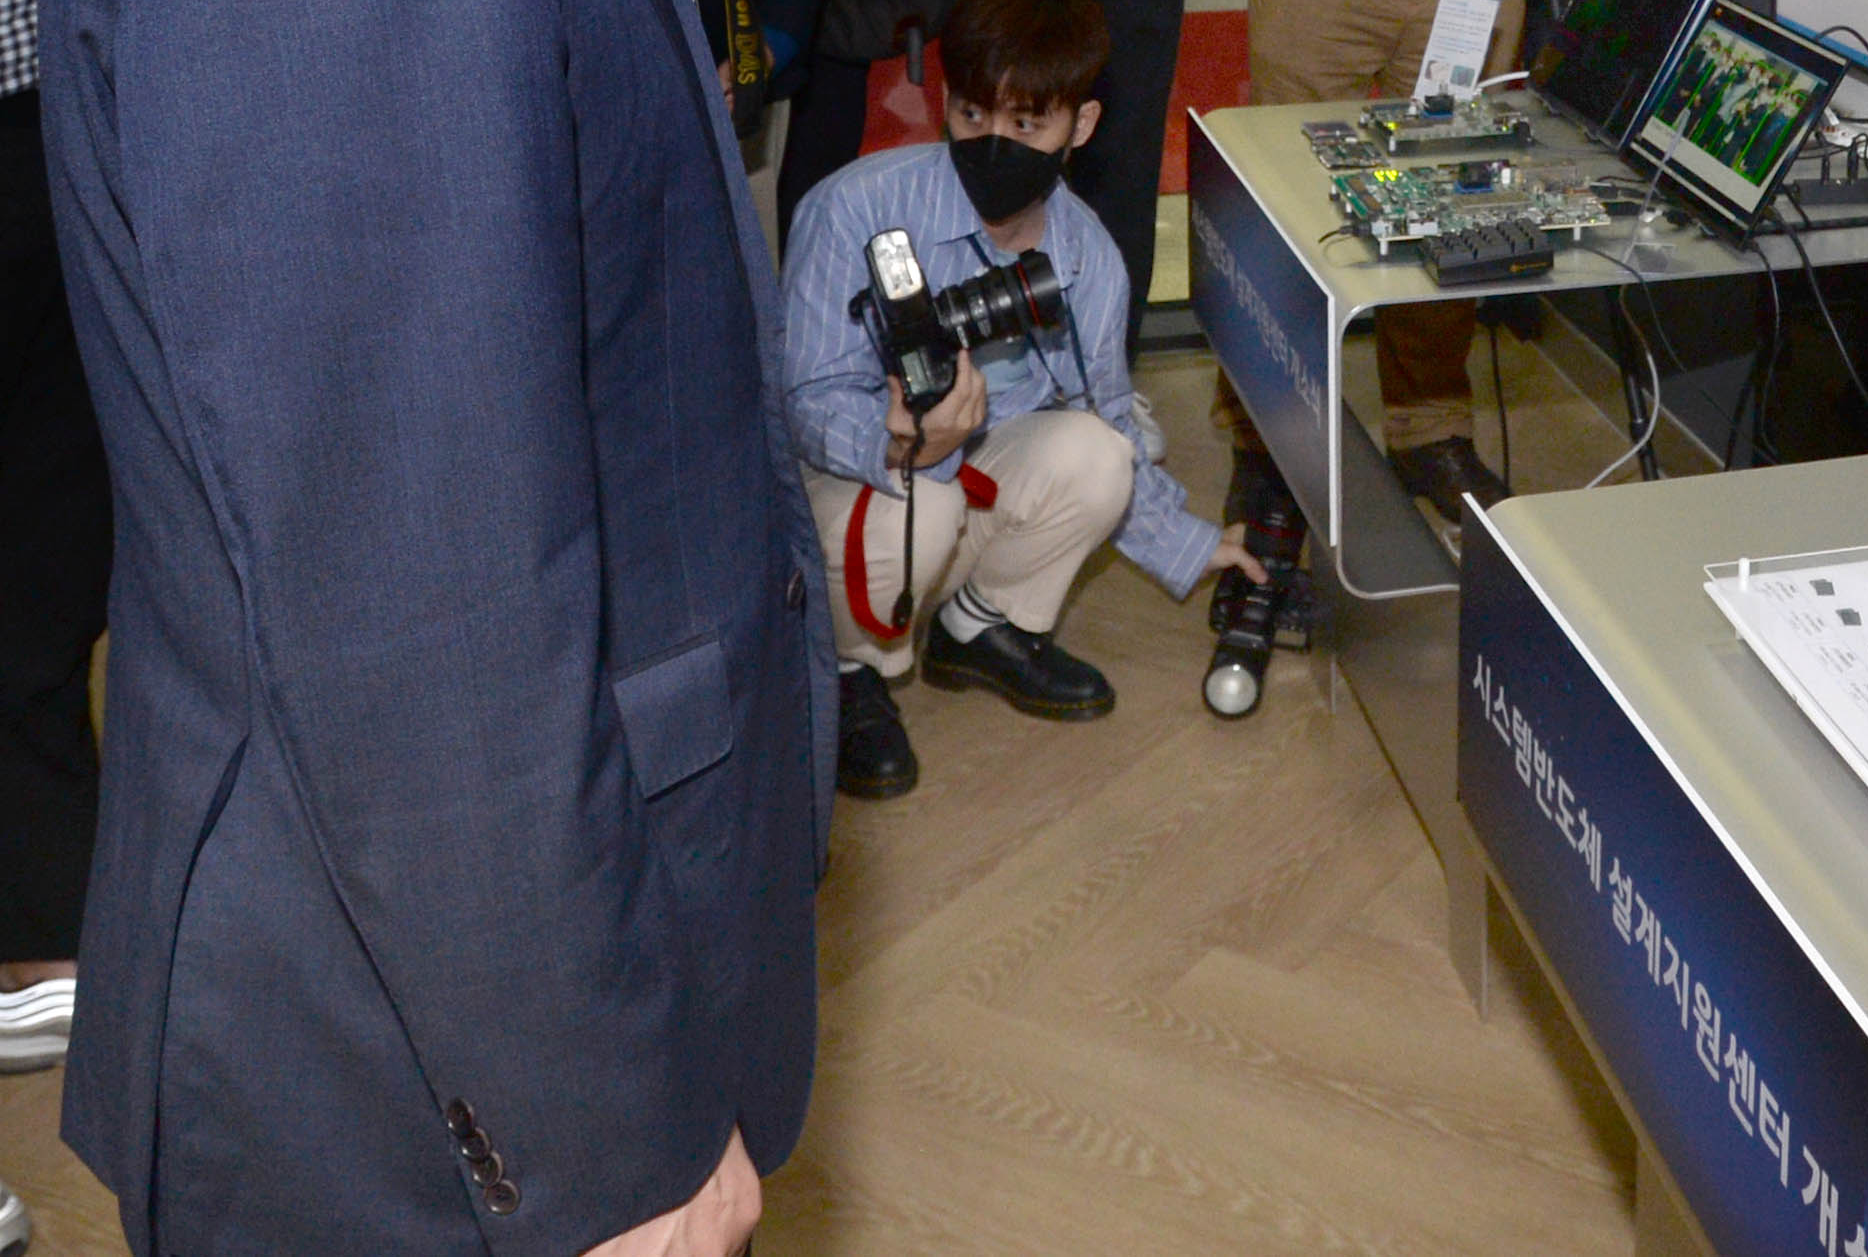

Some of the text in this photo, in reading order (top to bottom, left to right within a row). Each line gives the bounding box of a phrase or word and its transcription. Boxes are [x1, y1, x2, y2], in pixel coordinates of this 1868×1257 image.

[1473, 654, 1868, 1257] 시스템반도체 설계지원센터 개
